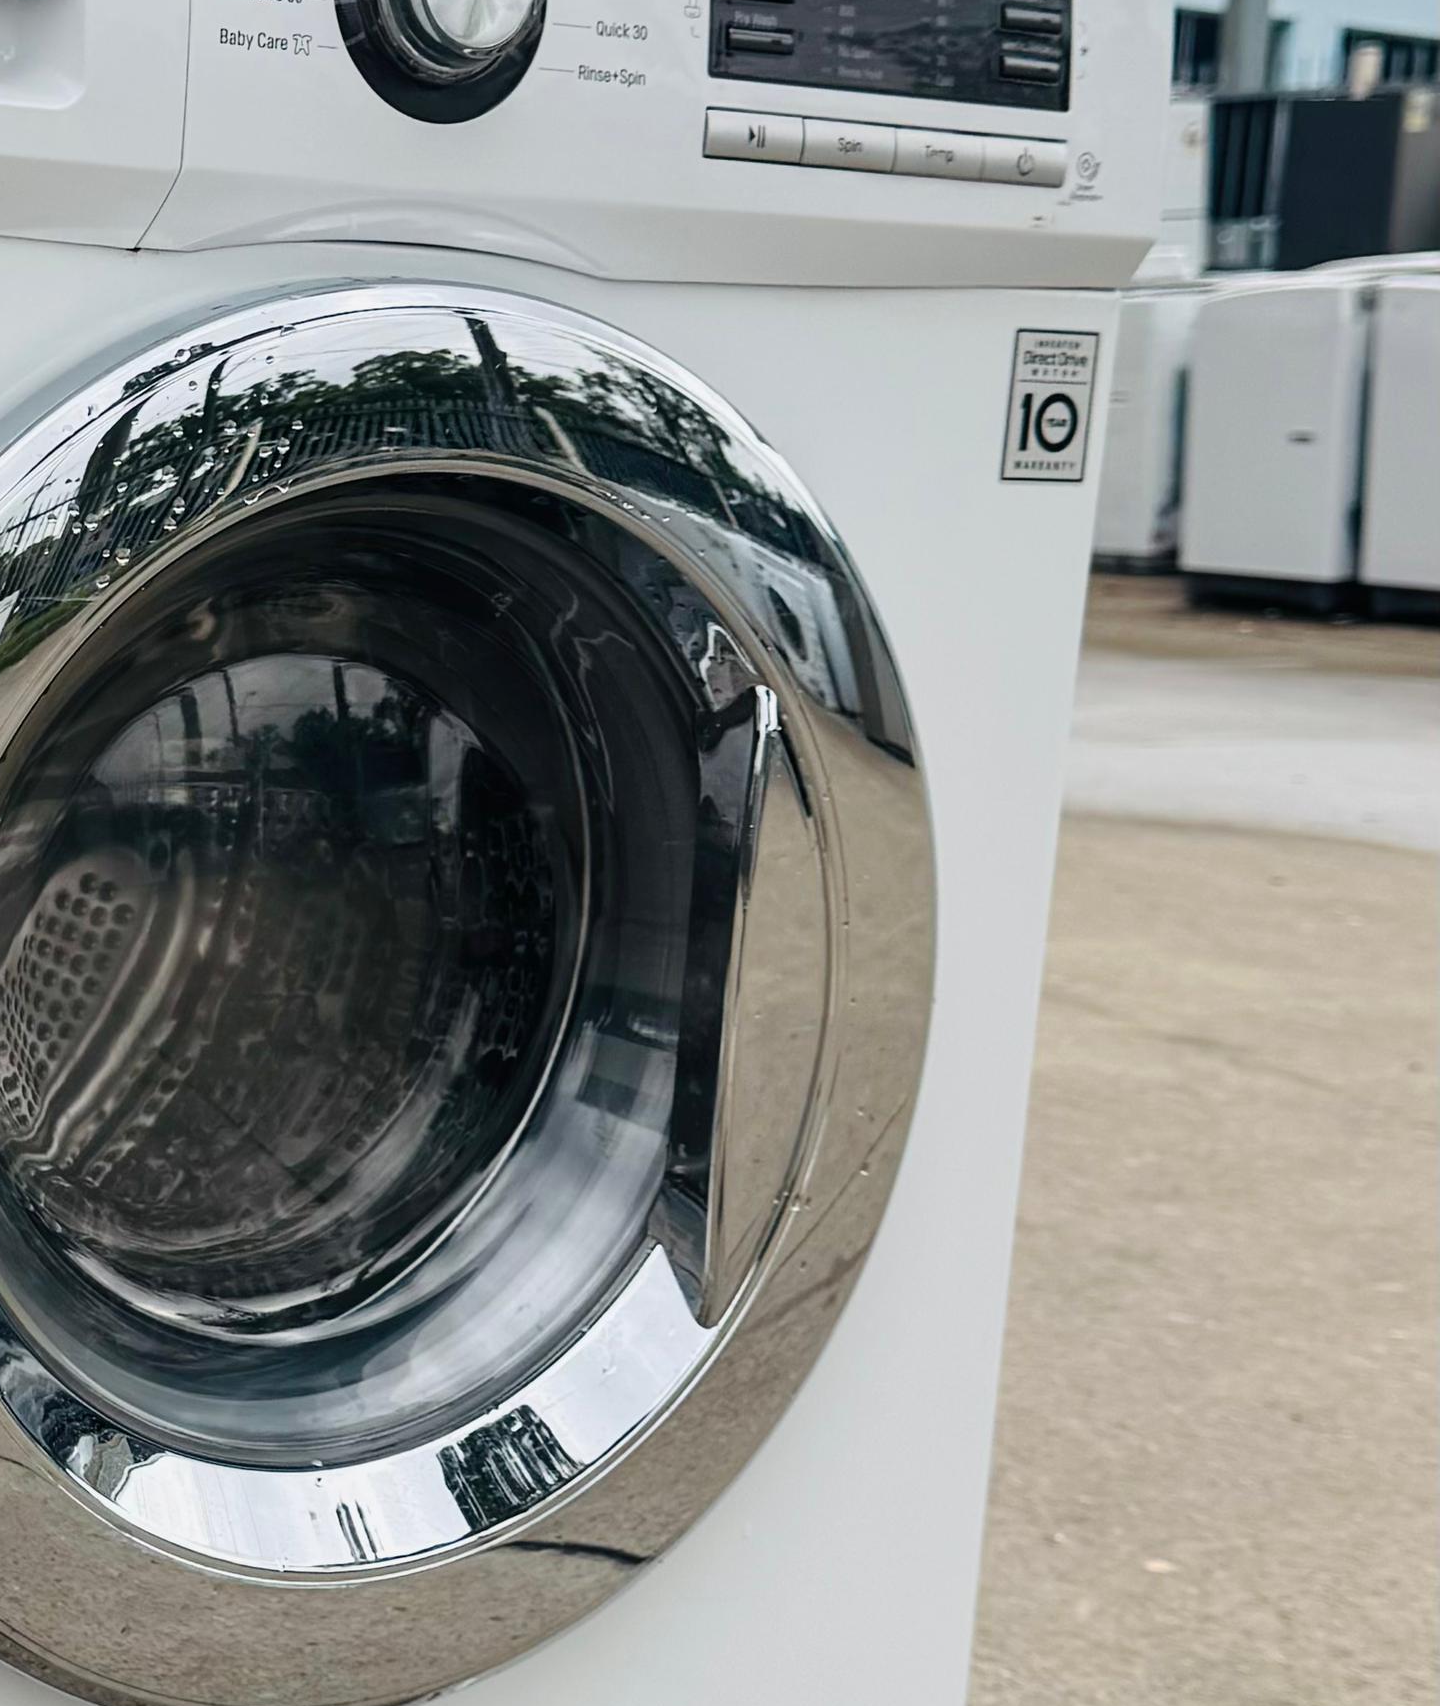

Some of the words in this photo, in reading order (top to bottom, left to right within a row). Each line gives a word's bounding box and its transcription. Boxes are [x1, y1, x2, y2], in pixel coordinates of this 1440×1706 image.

[220, 28, 253, 49] Baby
[258, 32, 288, 51] Care
[596, 21, 628, 40] Quick
[632, 24, 647, 40] 30
[578, 65, 646, 87] Rinse+Spin
[837, 137, 862, 153] Spin
[1018, 393, 1079, 453] 10
